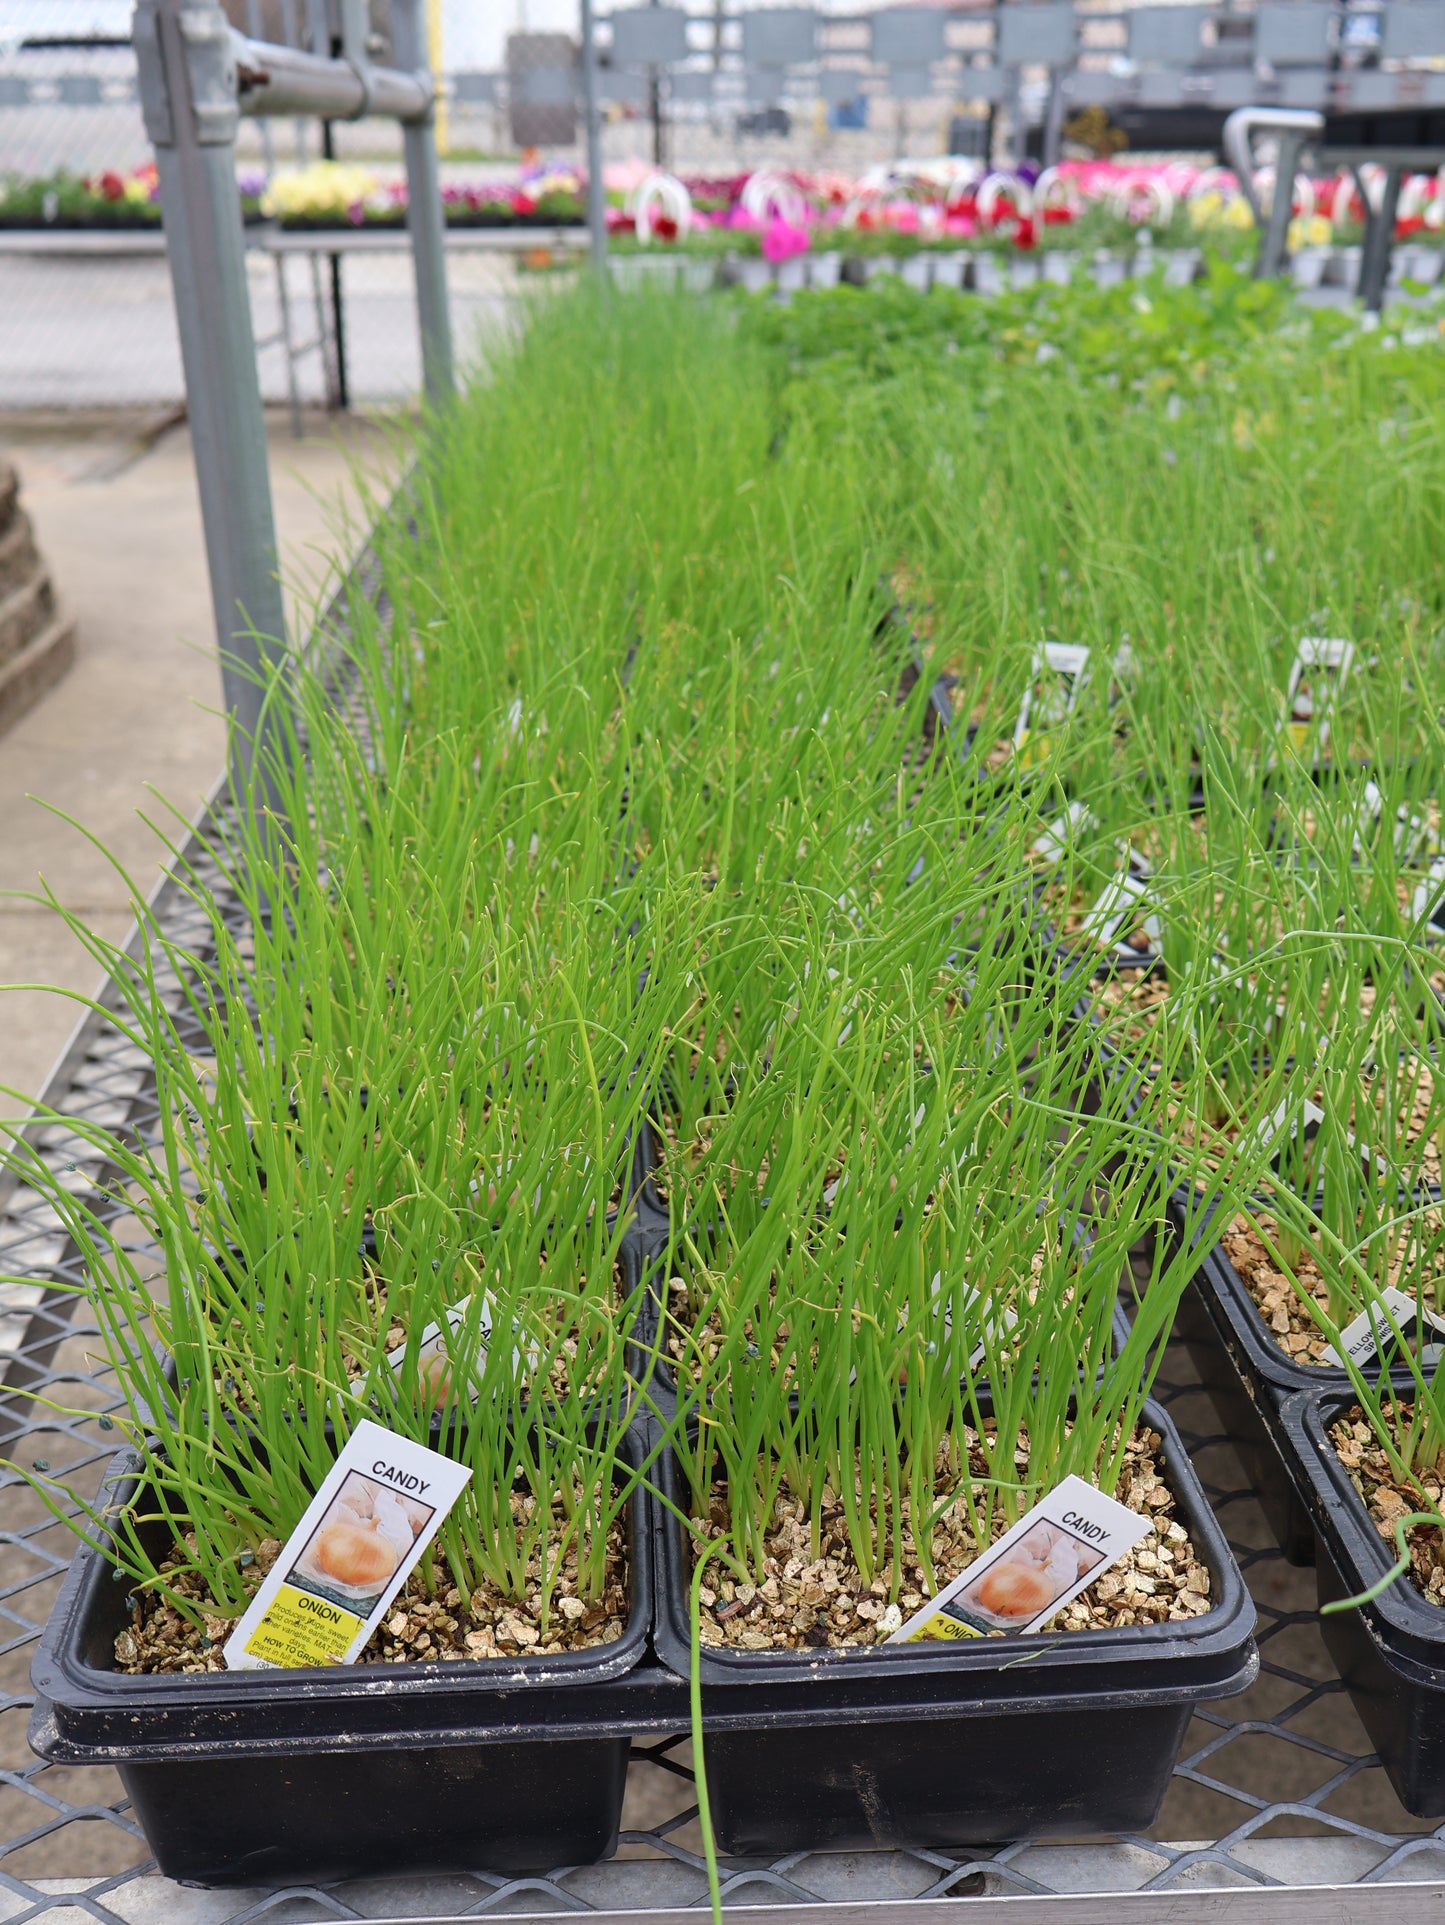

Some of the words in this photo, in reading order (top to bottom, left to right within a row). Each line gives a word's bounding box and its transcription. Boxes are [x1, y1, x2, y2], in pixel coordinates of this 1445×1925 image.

[1347, 1329, 1374, 1358] ELLOW
[1375, 1304, 1401, 1331] SWET
[1363, 1324, 1393, 1353] SPNIS
[371, 1460, 431, 1495] CANDY
[1061, 1511, 1111, 1543] CANDY
[272, 1602, 306, 1621] Produces
[298, 1597, 342, 1625] ONION
[263, 1636, 284, 1648] HOW
[285, 1644, 297, 1654] TO
[267, 1611, 283, 1621] mild
[308, 1628, 331, 1642] earlier
[330, 1639, 347, 1650] than
[252, 1640, 272, 1653] Plant
[272, 1648, 279, 1657] in
